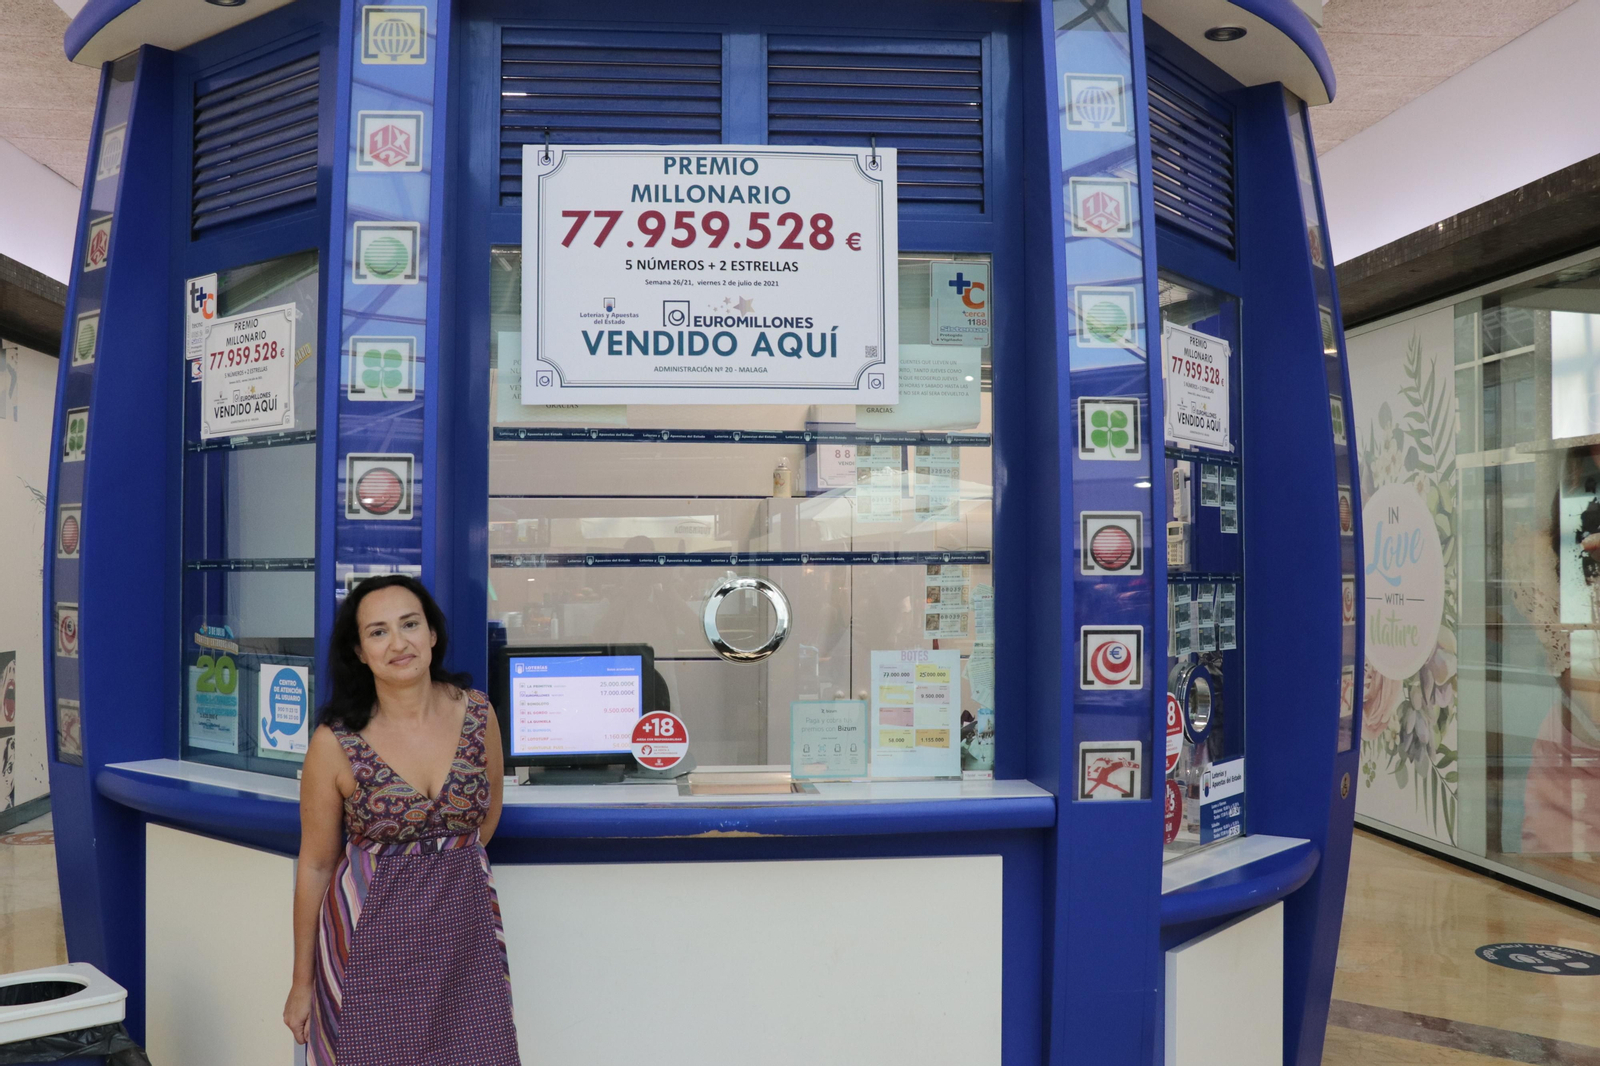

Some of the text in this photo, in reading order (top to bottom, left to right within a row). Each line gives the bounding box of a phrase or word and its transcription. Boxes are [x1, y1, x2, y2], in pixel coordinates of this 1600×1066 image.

[663, 156, 759, 176] PREMIO
[630, 184, 791, 204] MILLONARIO
[560, 210, 862, 252] 77.959.528 €
[625, 257, 798, 272] 5 NÚMEROS + 2 ESTRELLAS
[234, 319, 258, 332] PREMIO
[693, 315, 814, 329] EUROMILLONES
[226, 330, 267, 346] MILLONARIO
[582, 326, 838, 359] VENDIDO AQUÍ
[1190, 336, 1207, 349] PREMIO
[210, 341, 278, 370] 77.959.528
[1184, 348, 1213, 364] MILLONARIO
[653, 365, 713, 373] ADMINISTRACIÓN
[1172, 356, 1220, 385] 77.959.528
[240, 392, 271, 402] EUROMILLONES
[214, 395, 278, 419] VENDIDO AQUÍ
[1196, 409, 1217, 419] EUROMILLONES
[1177, 412, 1221, 432] VENDIDO AQUÍ
[1388, 506, 1399, 524] IN
[1366, 521, 1425, 587] Love
[1385, 593, 1404, 605] WITH
[1370, 608, 1420, 648] Nature
[901, 650, 929, 661] BOTES
[196, 655, 237, 694] 20
[281, 687, 302, 695] ATENCIÓN
[642, 718, 674, 736] +18
[1212, 779, 1226, 788] Apuestas
[1232, 774, 1242, 783] Estado
[1550, 947, 1594, 958] TURNO
